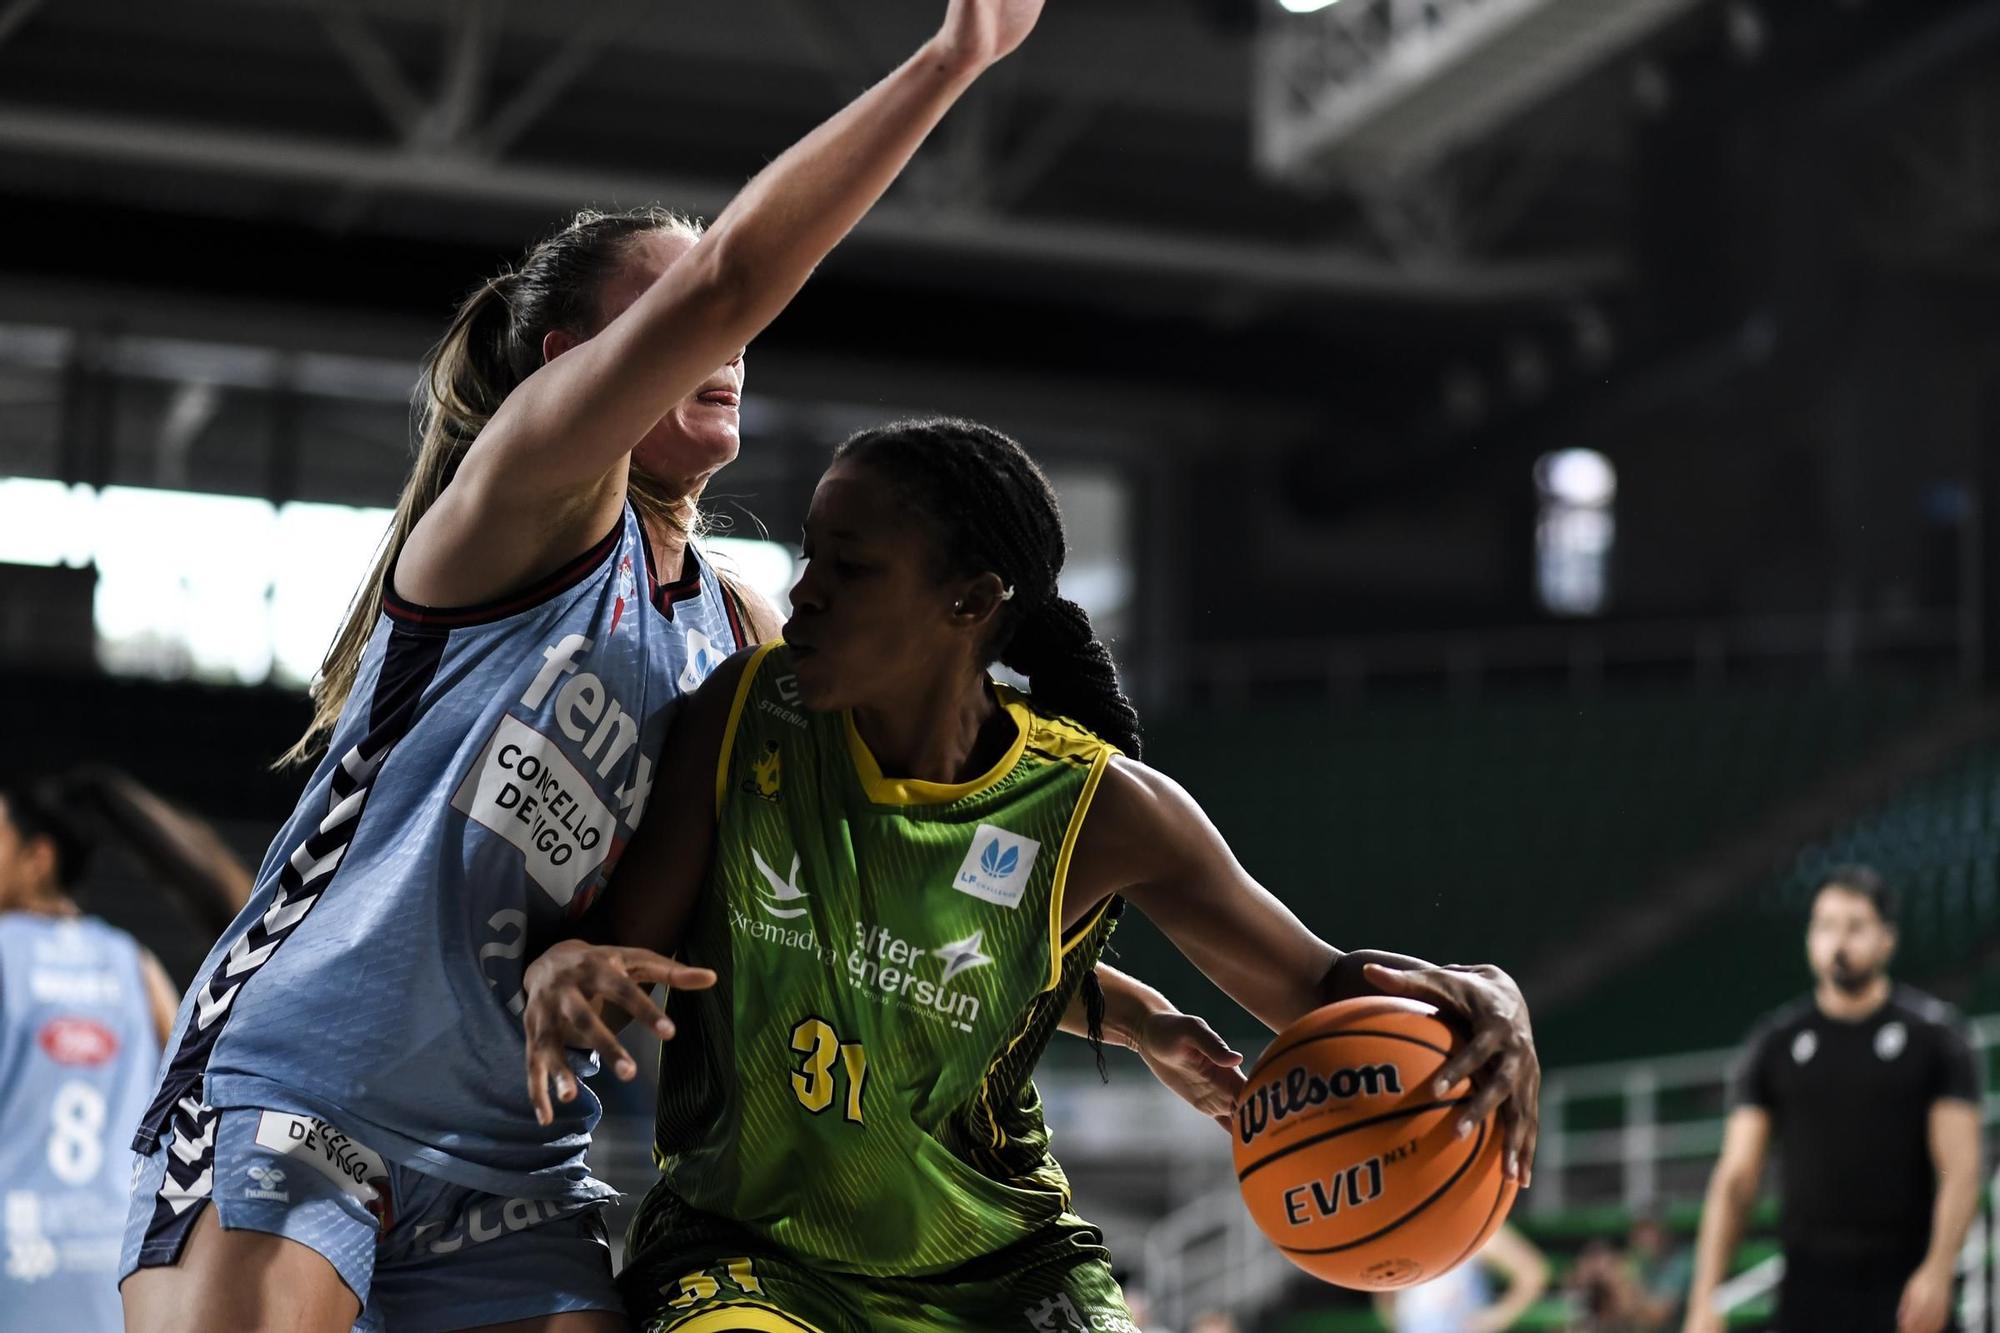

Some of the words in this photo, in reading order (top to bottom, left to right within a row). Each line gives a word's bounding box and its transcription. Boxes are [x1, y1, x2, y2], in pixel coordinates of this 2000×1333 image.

[498, 744, 600, 850] CONCELLO
[961, 871, 977, 884] LF
[856, 921, 926, 970] alter
[847, 949, 980, 1021] enersun
[790, 1014, 868, 1128] 31
[1238, 1063, 1402, 1144] Wilson
[50, 1083, 106, 1182] 8
[288, 1120, 316, 1151] DE
[244, 1187, 290, 1202] hummel
[1285, 1158, 1382, 1225] EVO
